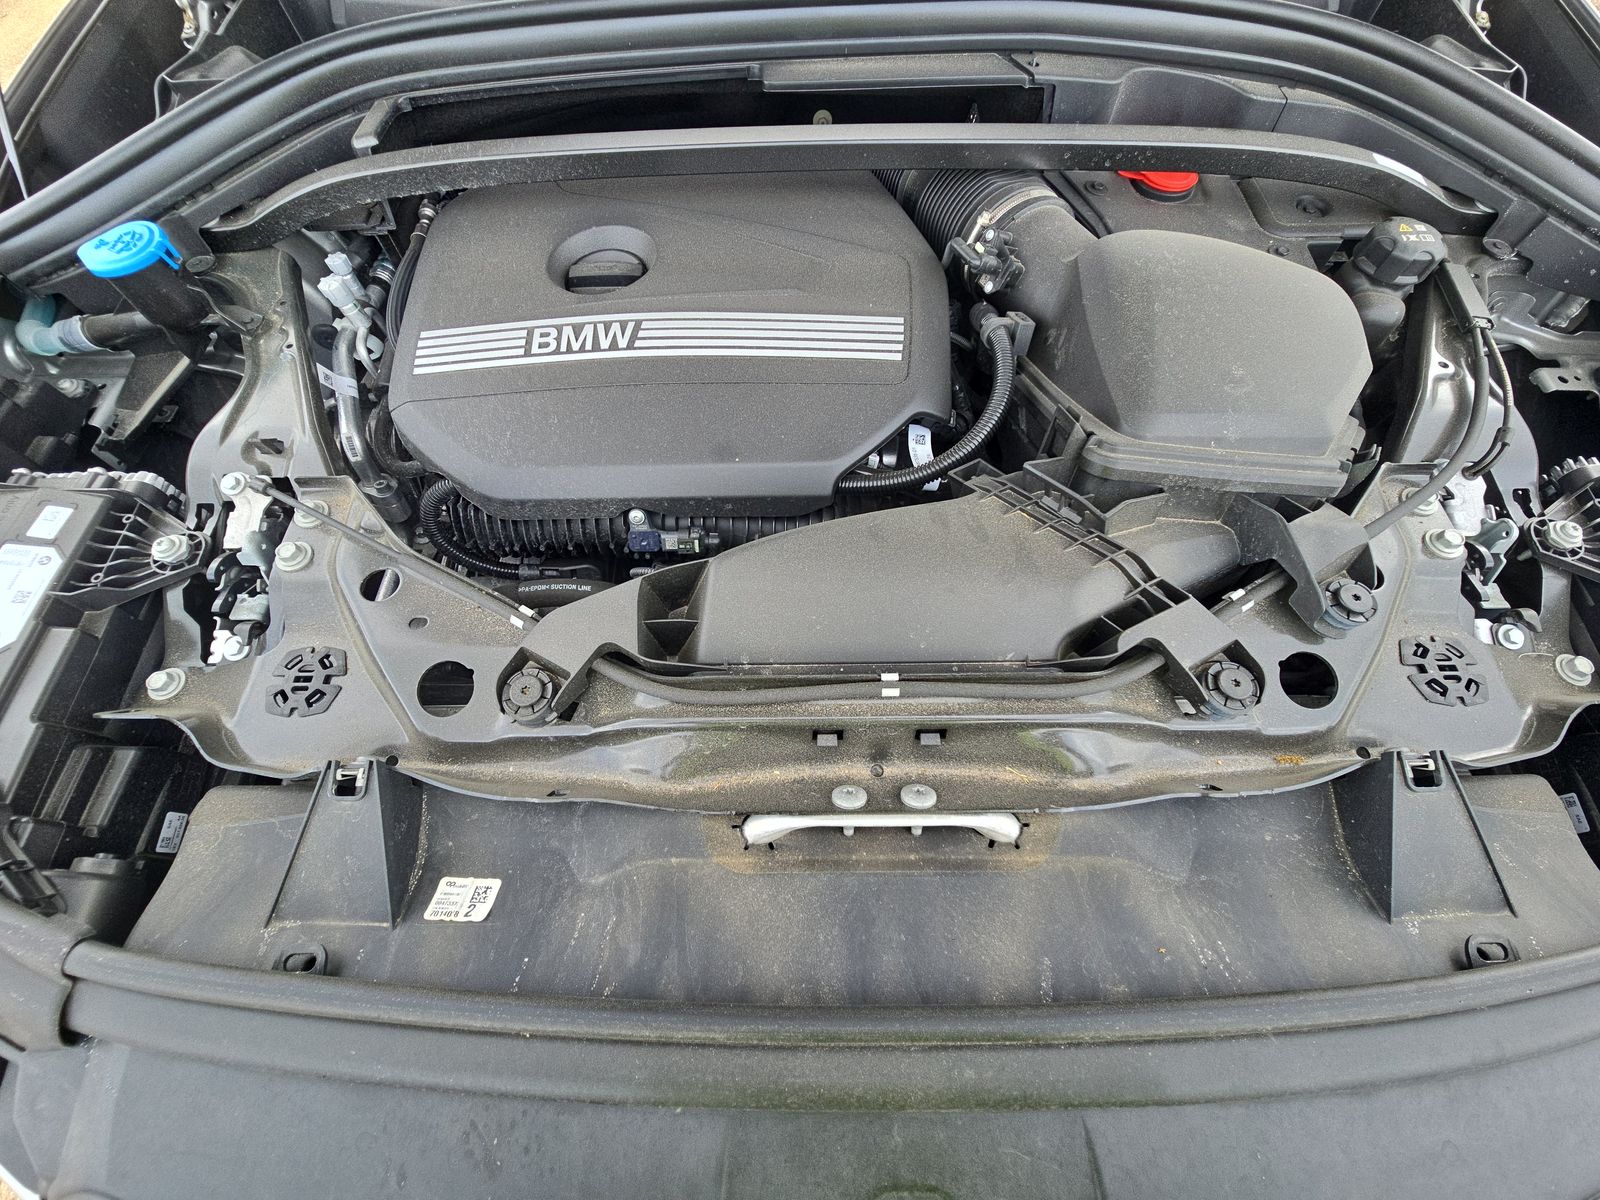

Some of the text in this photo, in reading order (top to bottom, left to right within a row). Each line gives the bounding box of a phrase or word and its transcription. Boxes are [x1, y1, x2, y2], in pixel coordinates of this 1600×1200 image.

[530, 321, 636, 354] BMW
[550, 583, 576, 591] SUCTION
[577, 584, 592, 592] LINE
[463, 903, 477, 918] 2
